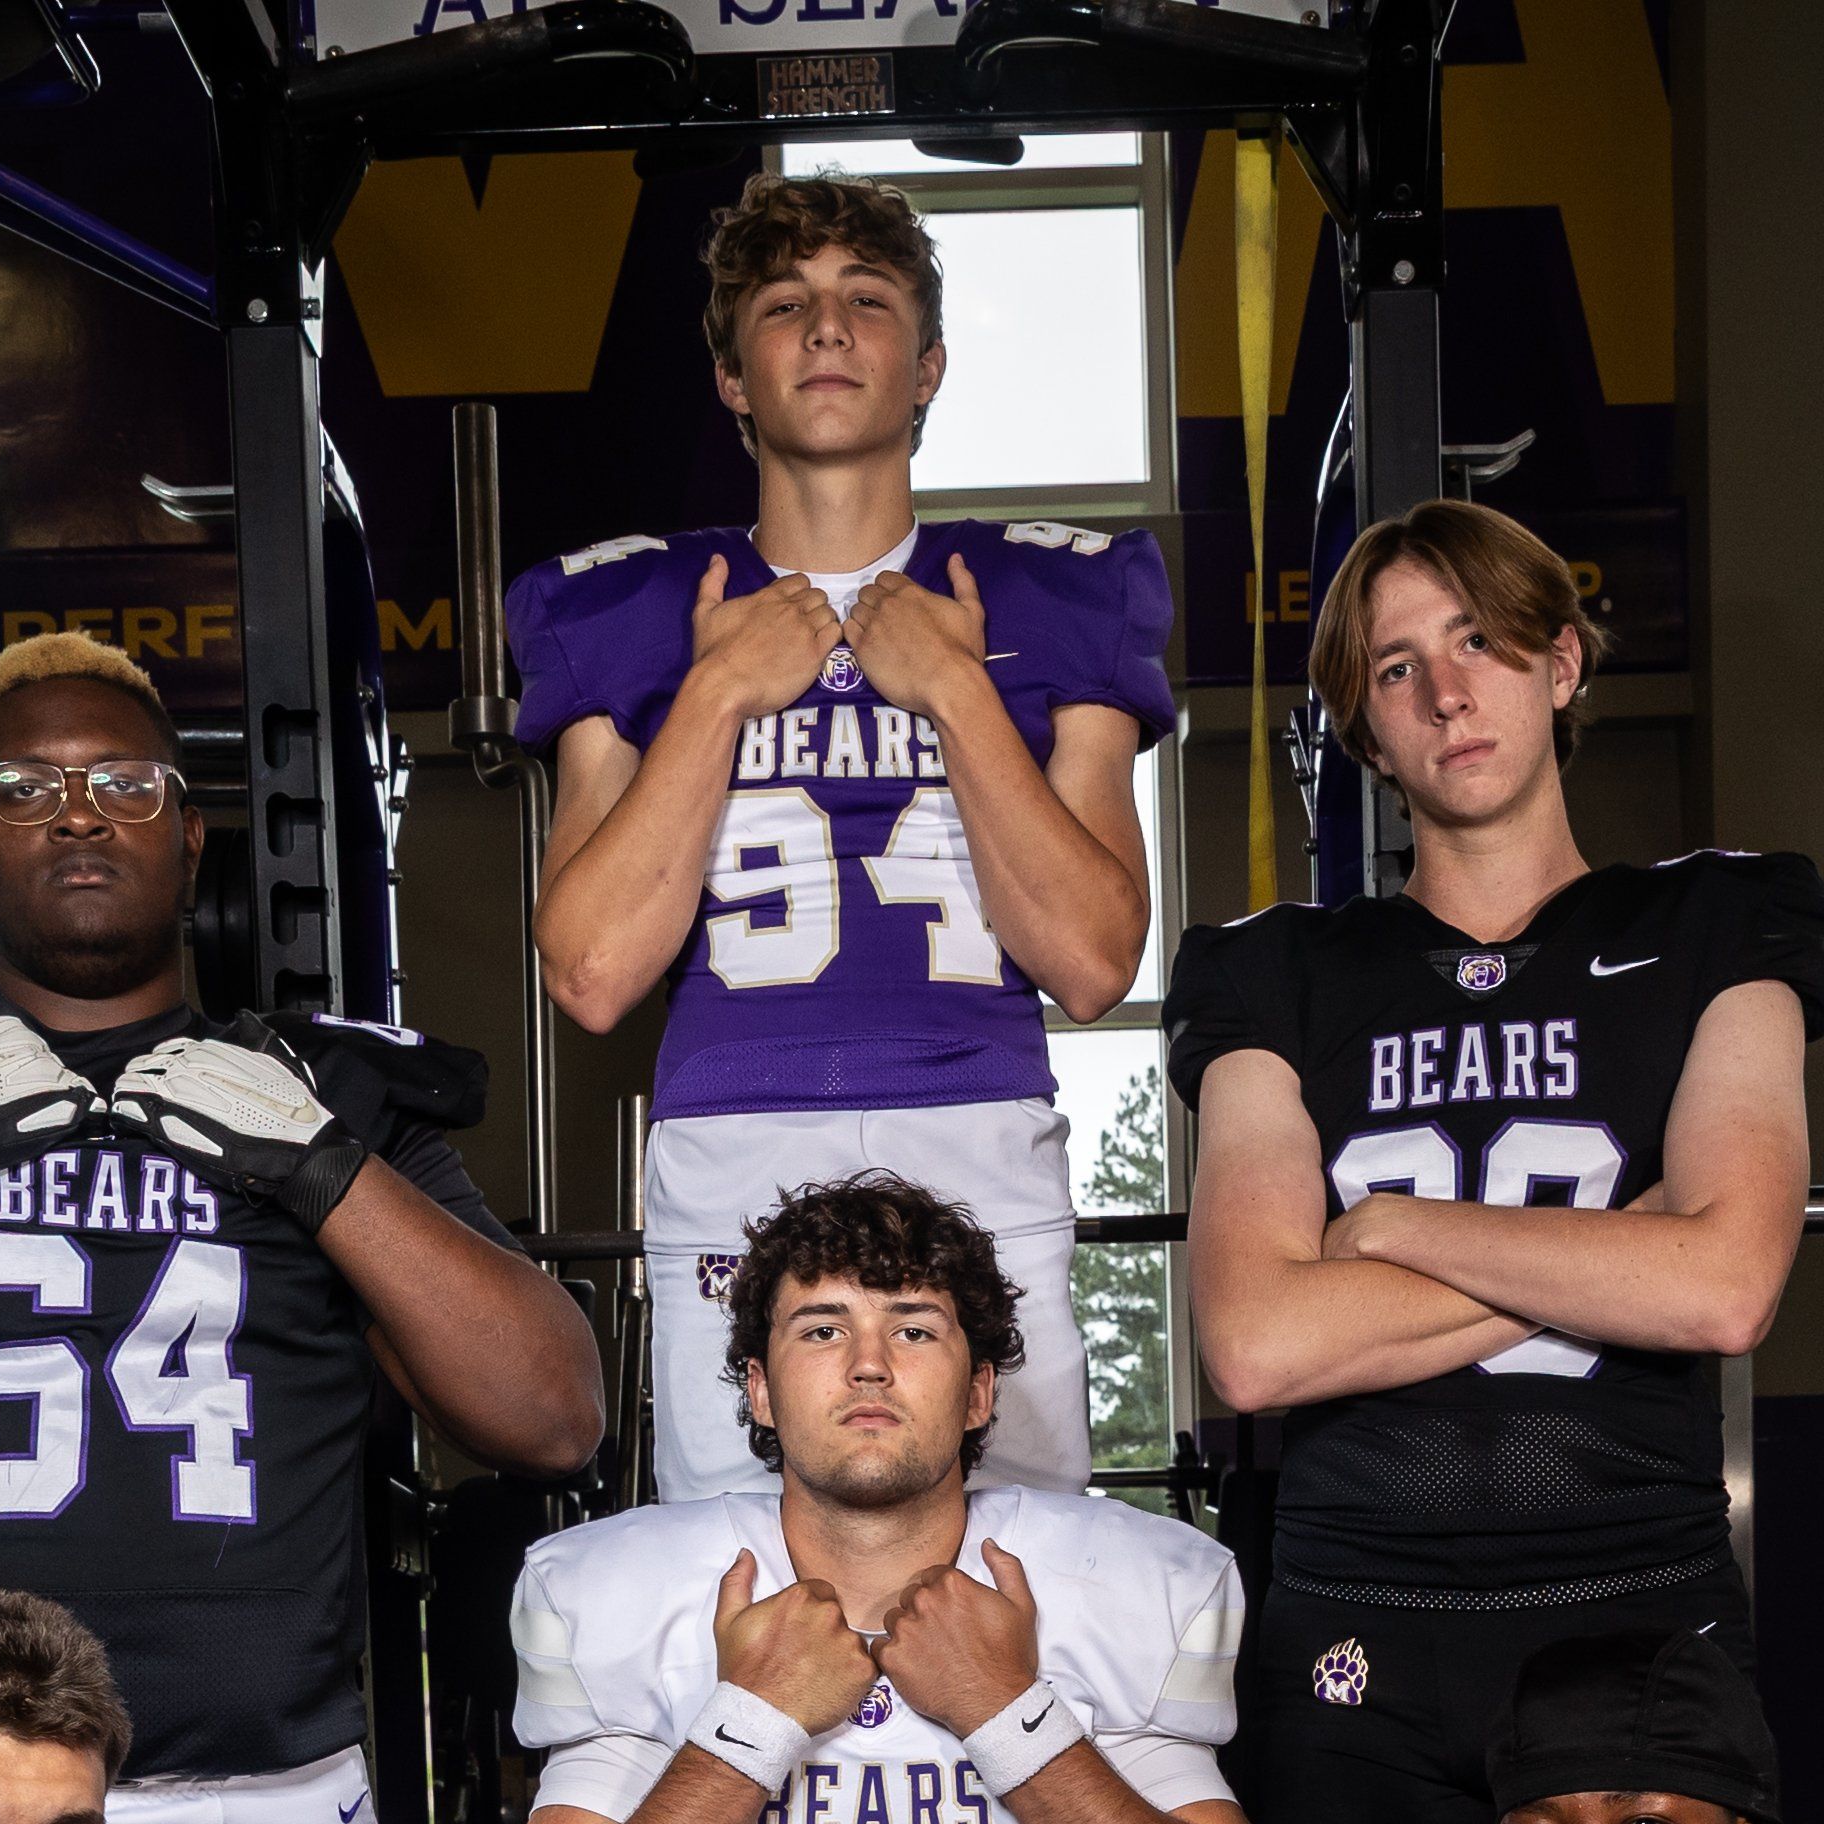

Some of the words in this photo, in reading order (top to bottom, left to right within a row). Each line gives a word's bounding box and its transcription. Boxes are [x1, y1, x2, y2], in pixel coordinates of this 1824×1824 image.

[767, 84, 887, 114] STRENGTH
[770, 57, 881, 90] HAMMER
[737, 704, 946, 779] BEARS
[704, 786, 1004, 990] 94
[1368, 1017, 1580, 1113] BEARS
[1324, 1678, 1351, 1704] M
